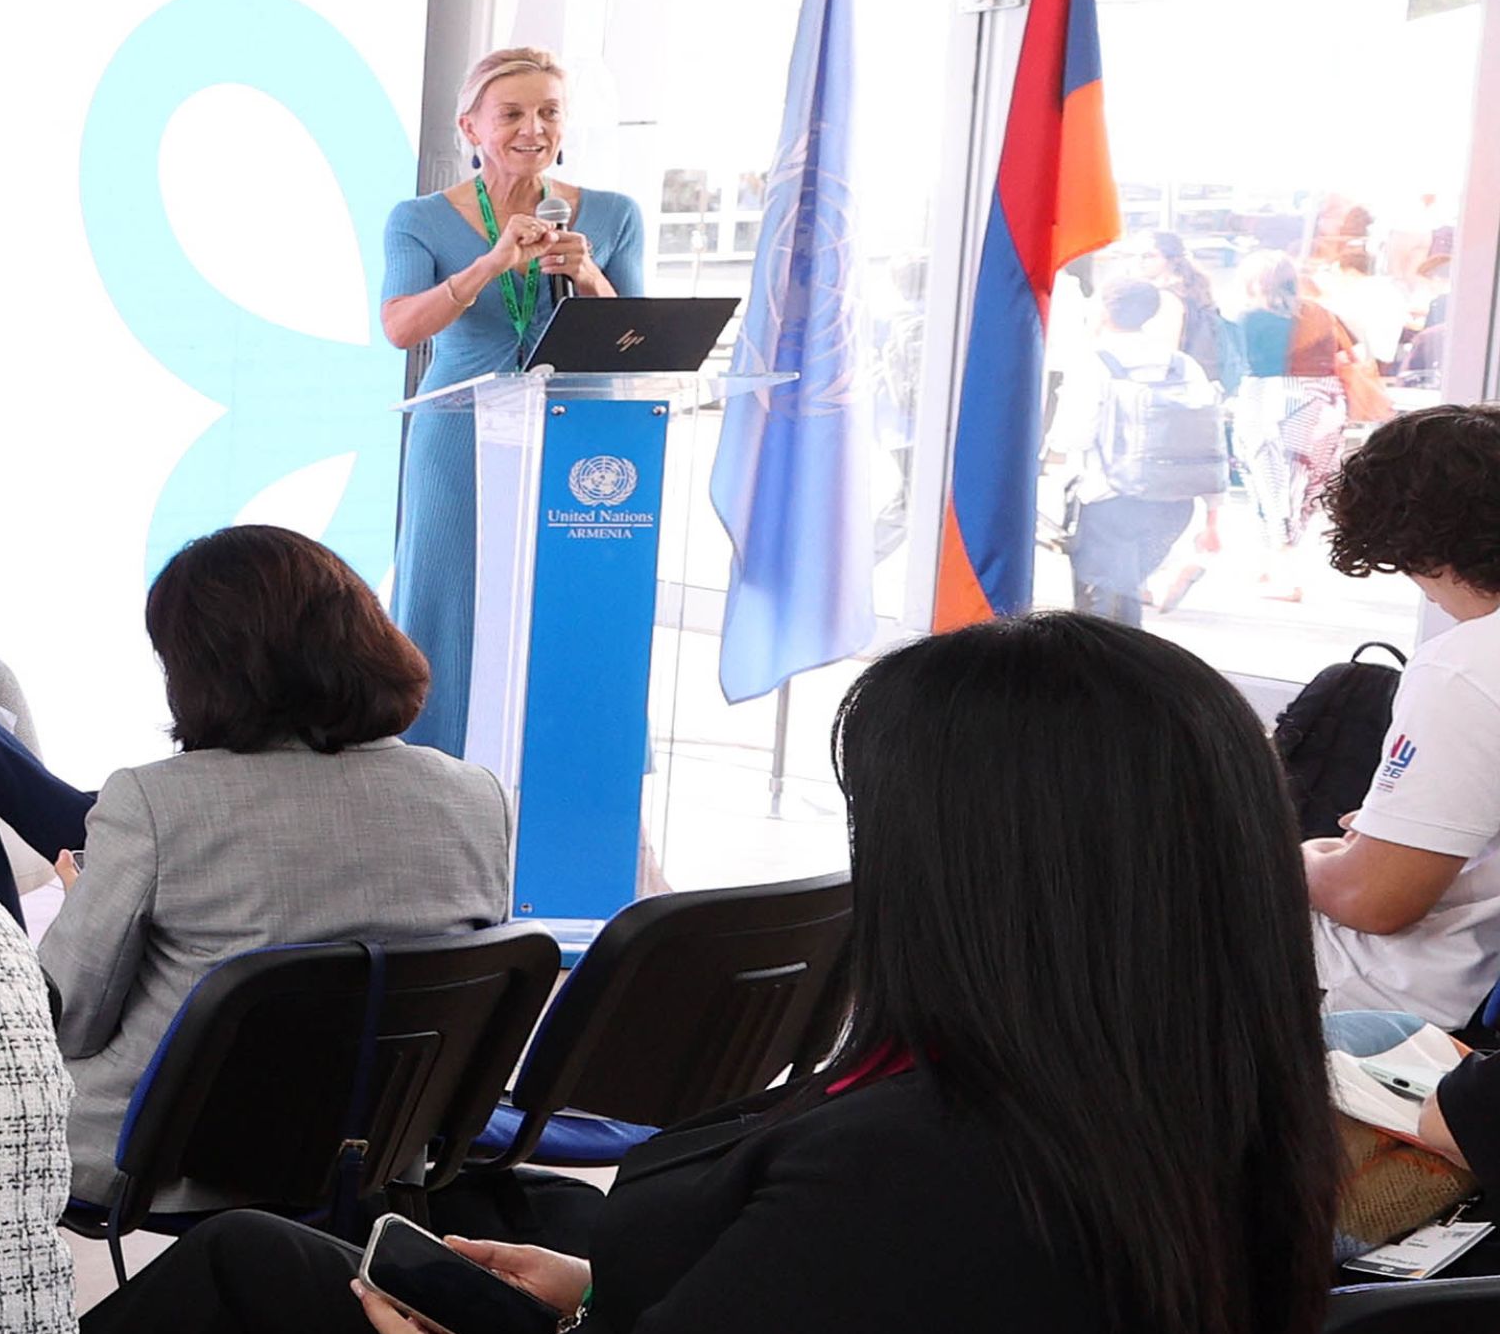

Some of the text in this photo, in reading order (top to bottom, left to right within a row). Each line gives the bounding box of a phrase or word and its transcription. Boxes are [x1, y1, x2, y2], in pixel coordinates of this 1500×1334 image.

[547, 509, 654, 522] United Nations
[567, 528, 633, 539] ARMENIA
